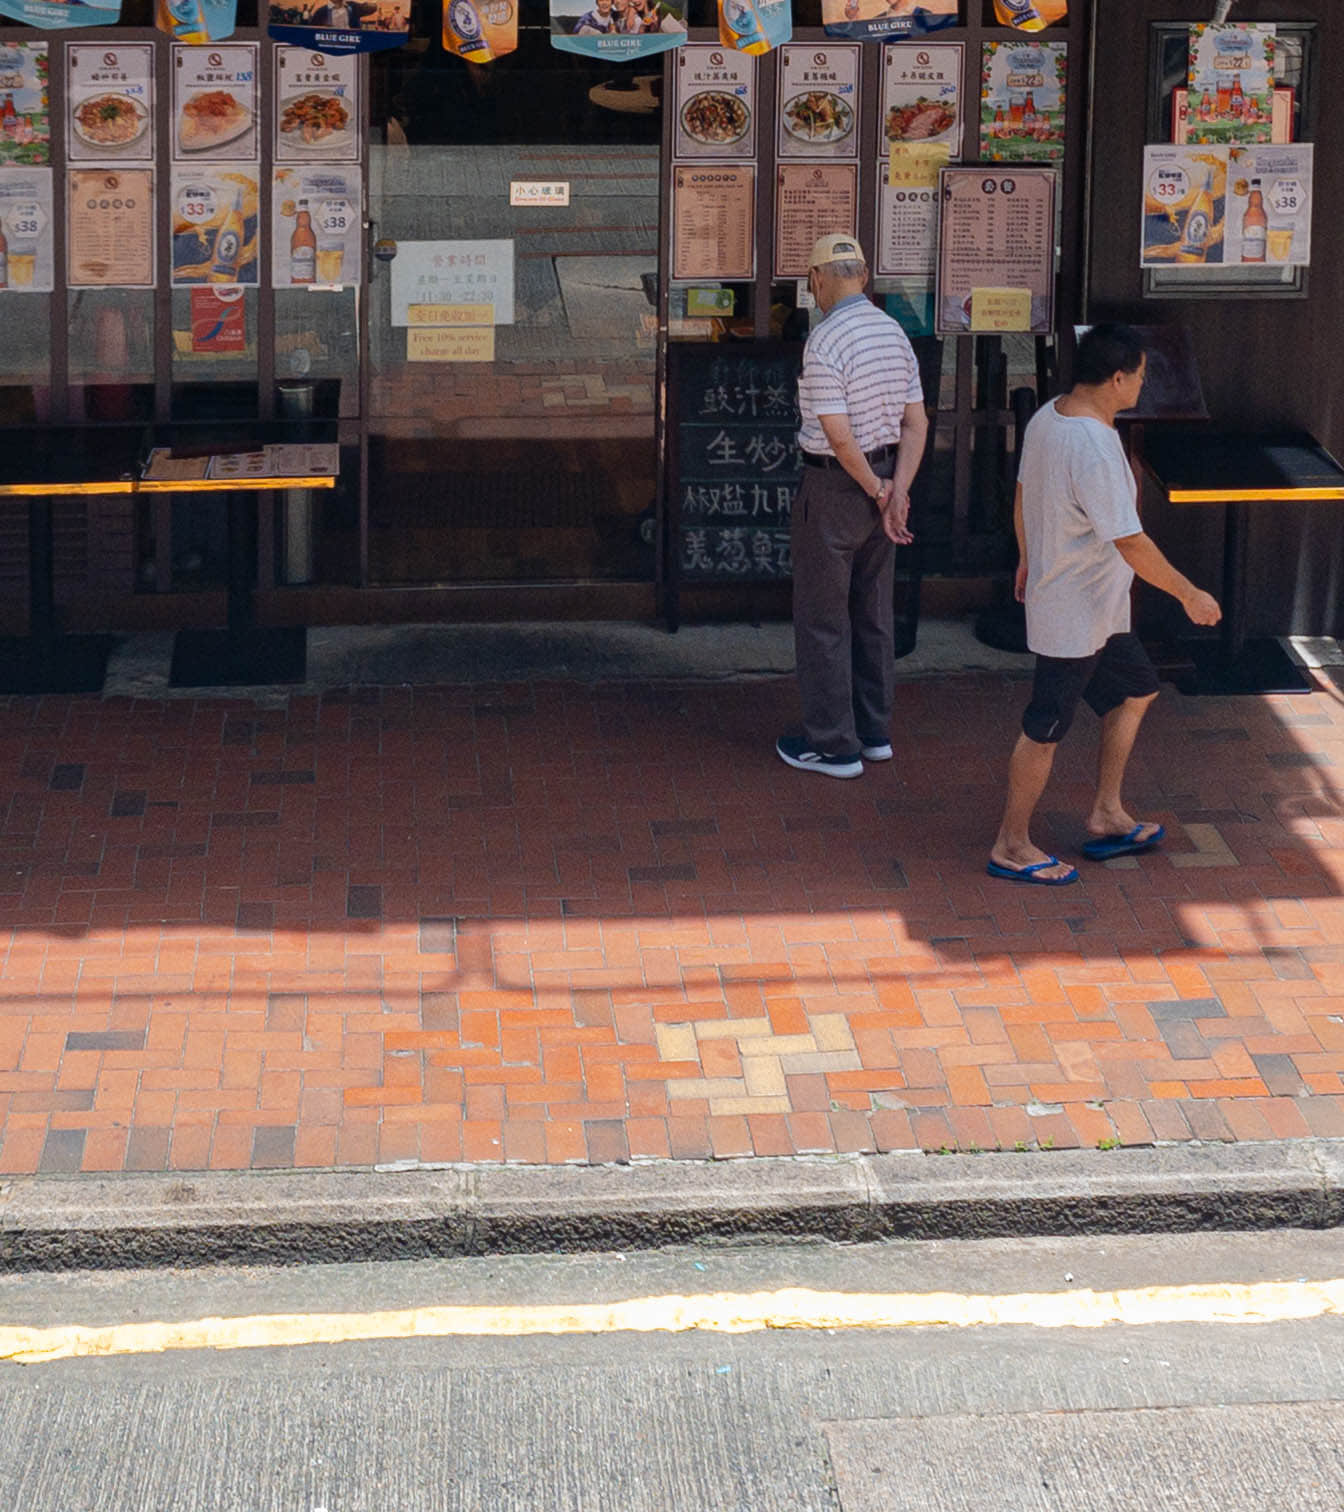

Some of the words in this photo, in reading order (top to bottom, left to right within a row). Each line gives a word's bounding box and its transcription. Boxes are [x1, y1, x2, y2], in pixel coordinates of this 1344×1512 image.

[867, 23, 889, 33] BLUE
[890, 21, 913, 31] GIRL
[315, 32, 337, 43] BLUE
[339, 33, 361, 44] GIRL
[1275, 197, 1297, 209] $38
[14, 220, 38, 234] $38
[323, 217, 346, 230] $38
[413, 332, 434, 343] Free
[456, 333, 489, 343] service
[699, 384, 798, 417] 豉汁蒸
